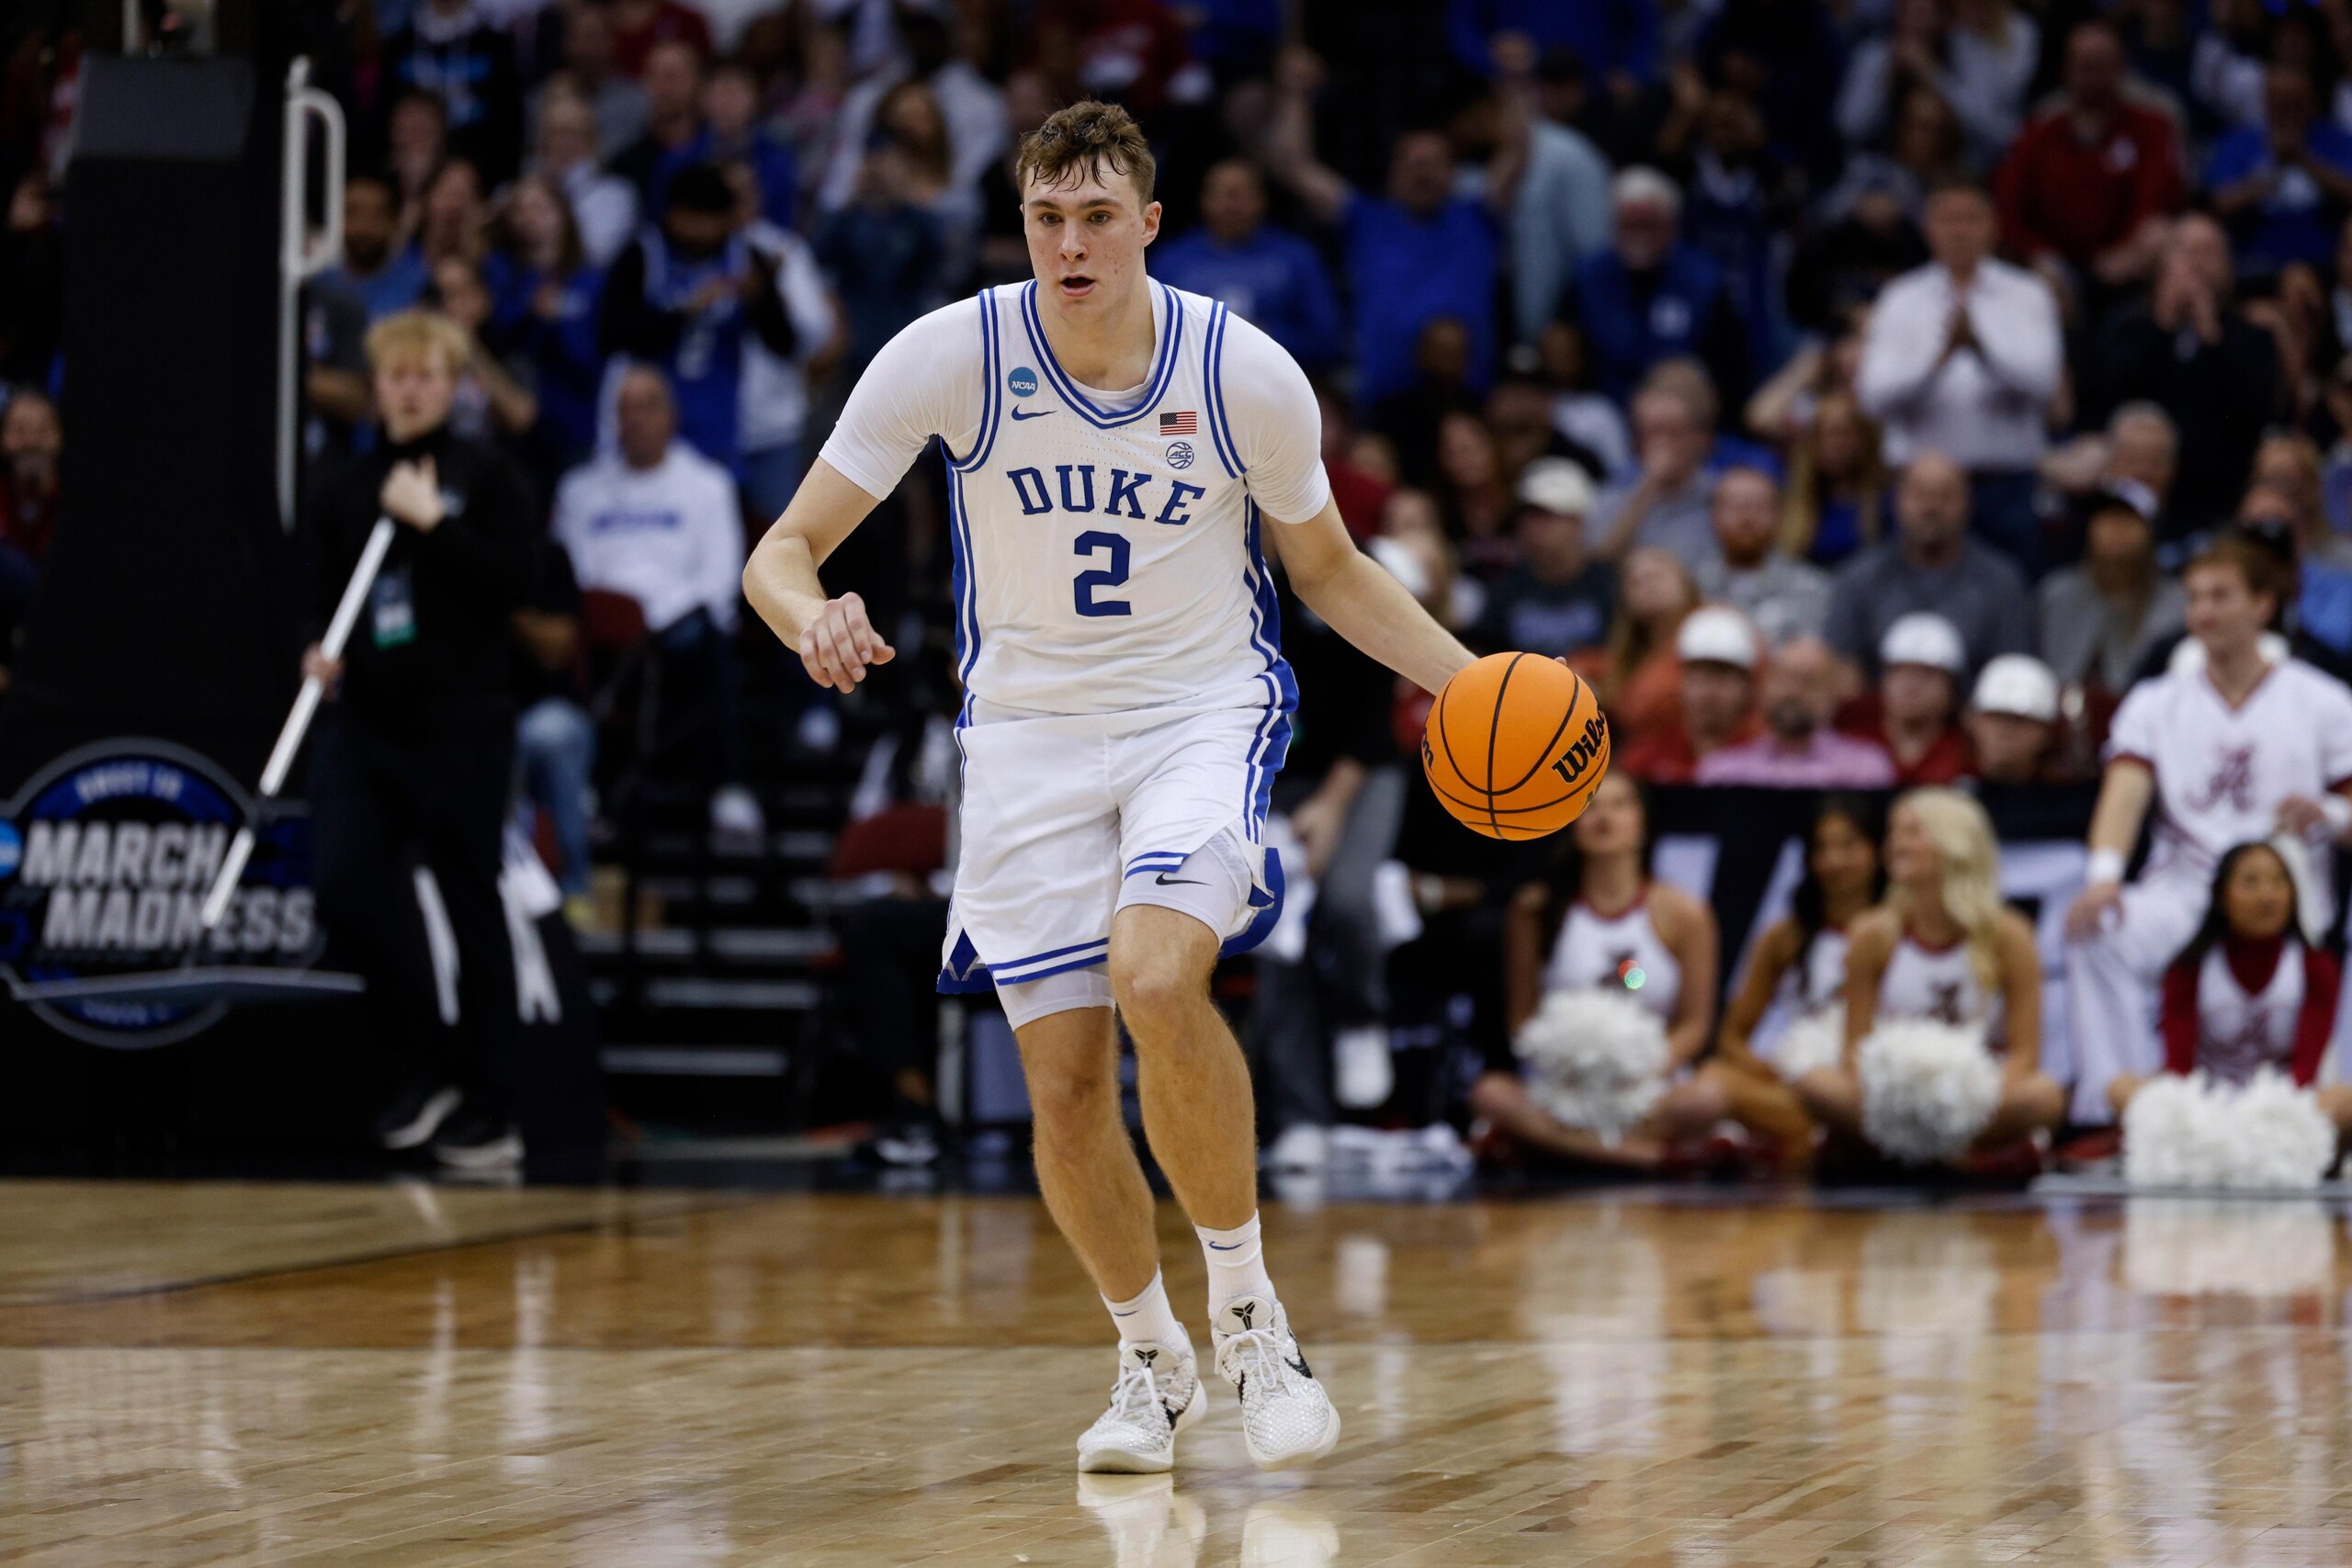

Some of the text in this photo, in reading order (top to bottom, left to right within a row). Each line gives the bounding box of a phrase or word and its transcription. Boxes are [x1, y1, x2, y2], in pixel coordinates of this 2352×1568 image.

[1012, 380, 1035, 391] NCAA
[1170, 450, 1193, 458] ACC
[1006, 465, 1205, 525] DUKE
[1073, 530, 1132, 616] 2
[22, 820, 228, 887] MARCH
